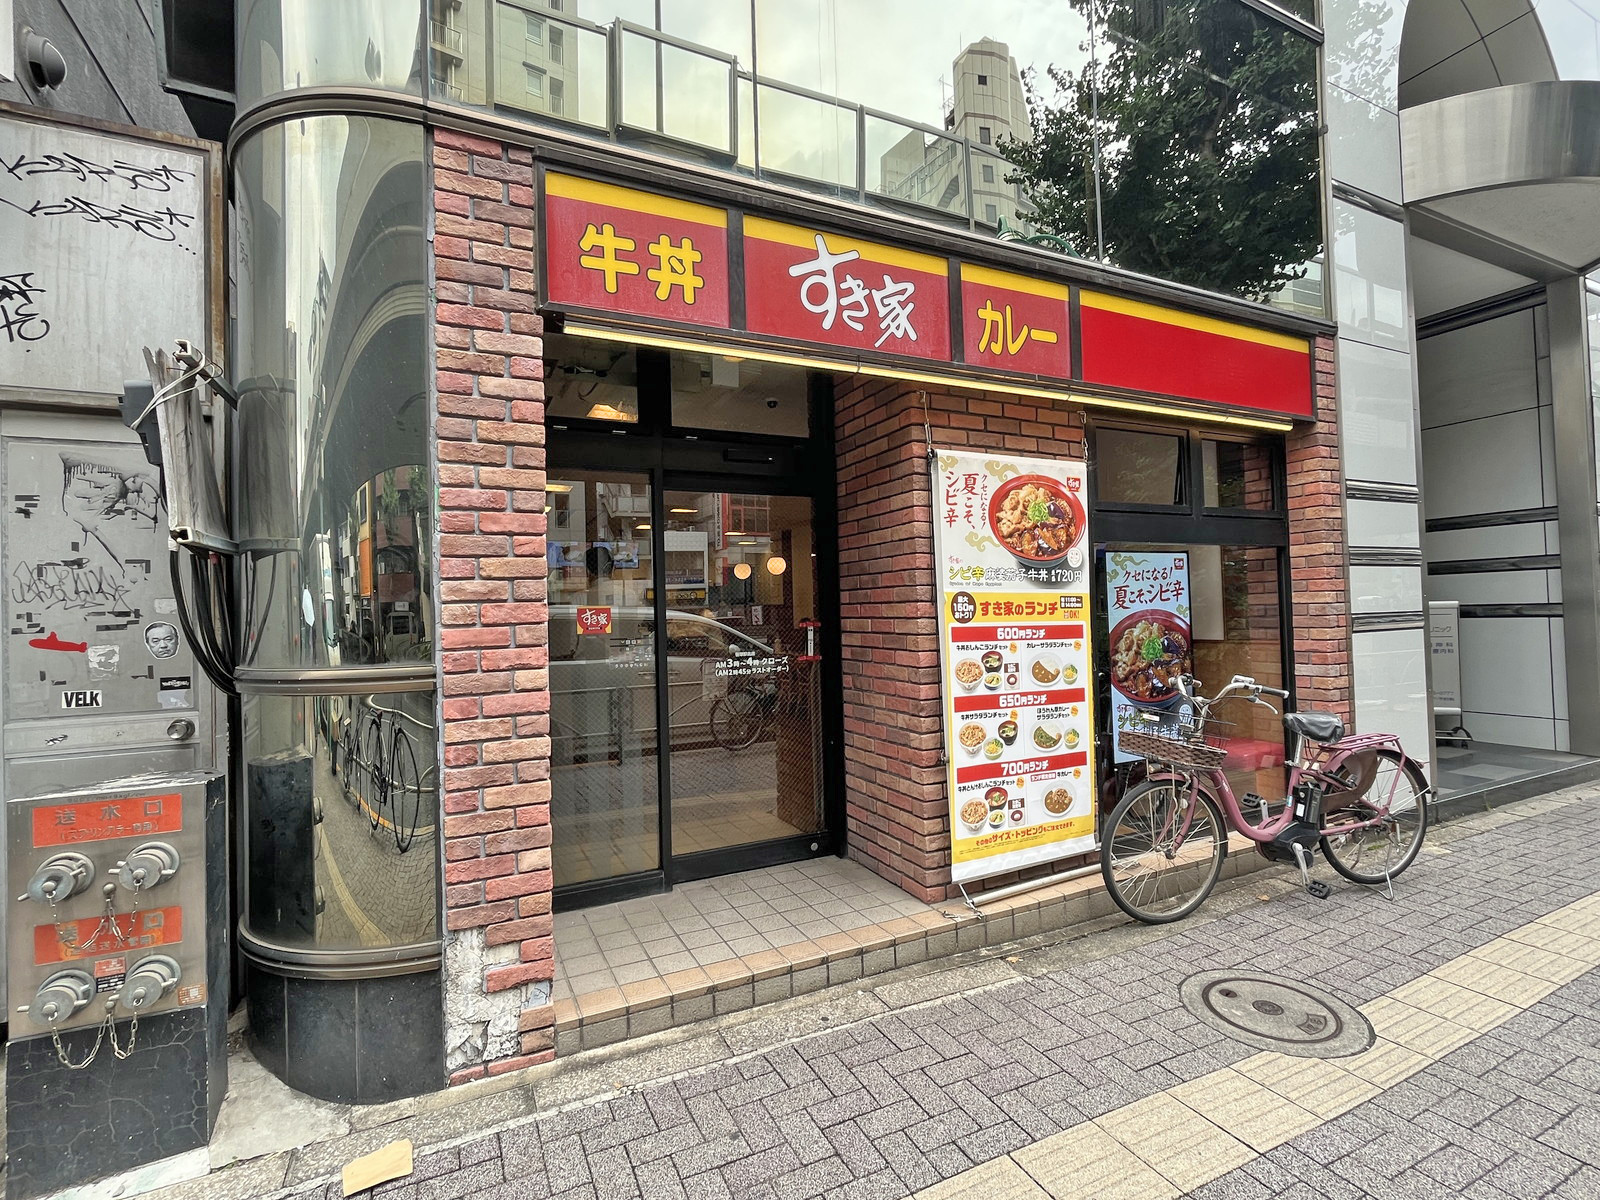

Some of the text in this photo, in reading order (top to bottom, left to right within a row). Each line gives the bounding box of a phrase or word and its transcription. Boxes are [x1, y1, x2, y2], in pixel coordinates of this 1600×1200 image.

[579, 222, 705, 305] 牛丼
[788, 233, 918, 348] すき家
[977, 299, 1059, 355] カレー
[943, 470, 961, 529] シビ辛
[979, 601, 1058, 616] すき家のランチ
[581, 609, 608, 627] すき家
[997, 627, 1046, 640] 600円ランチ
[64, 691, 100, 708] VELK
[999, 693, 1048, 707] 650円ランチ
[1000, 760, 1049, 776] 700円ランチ
[54, 799, 163, 827] 送水口
